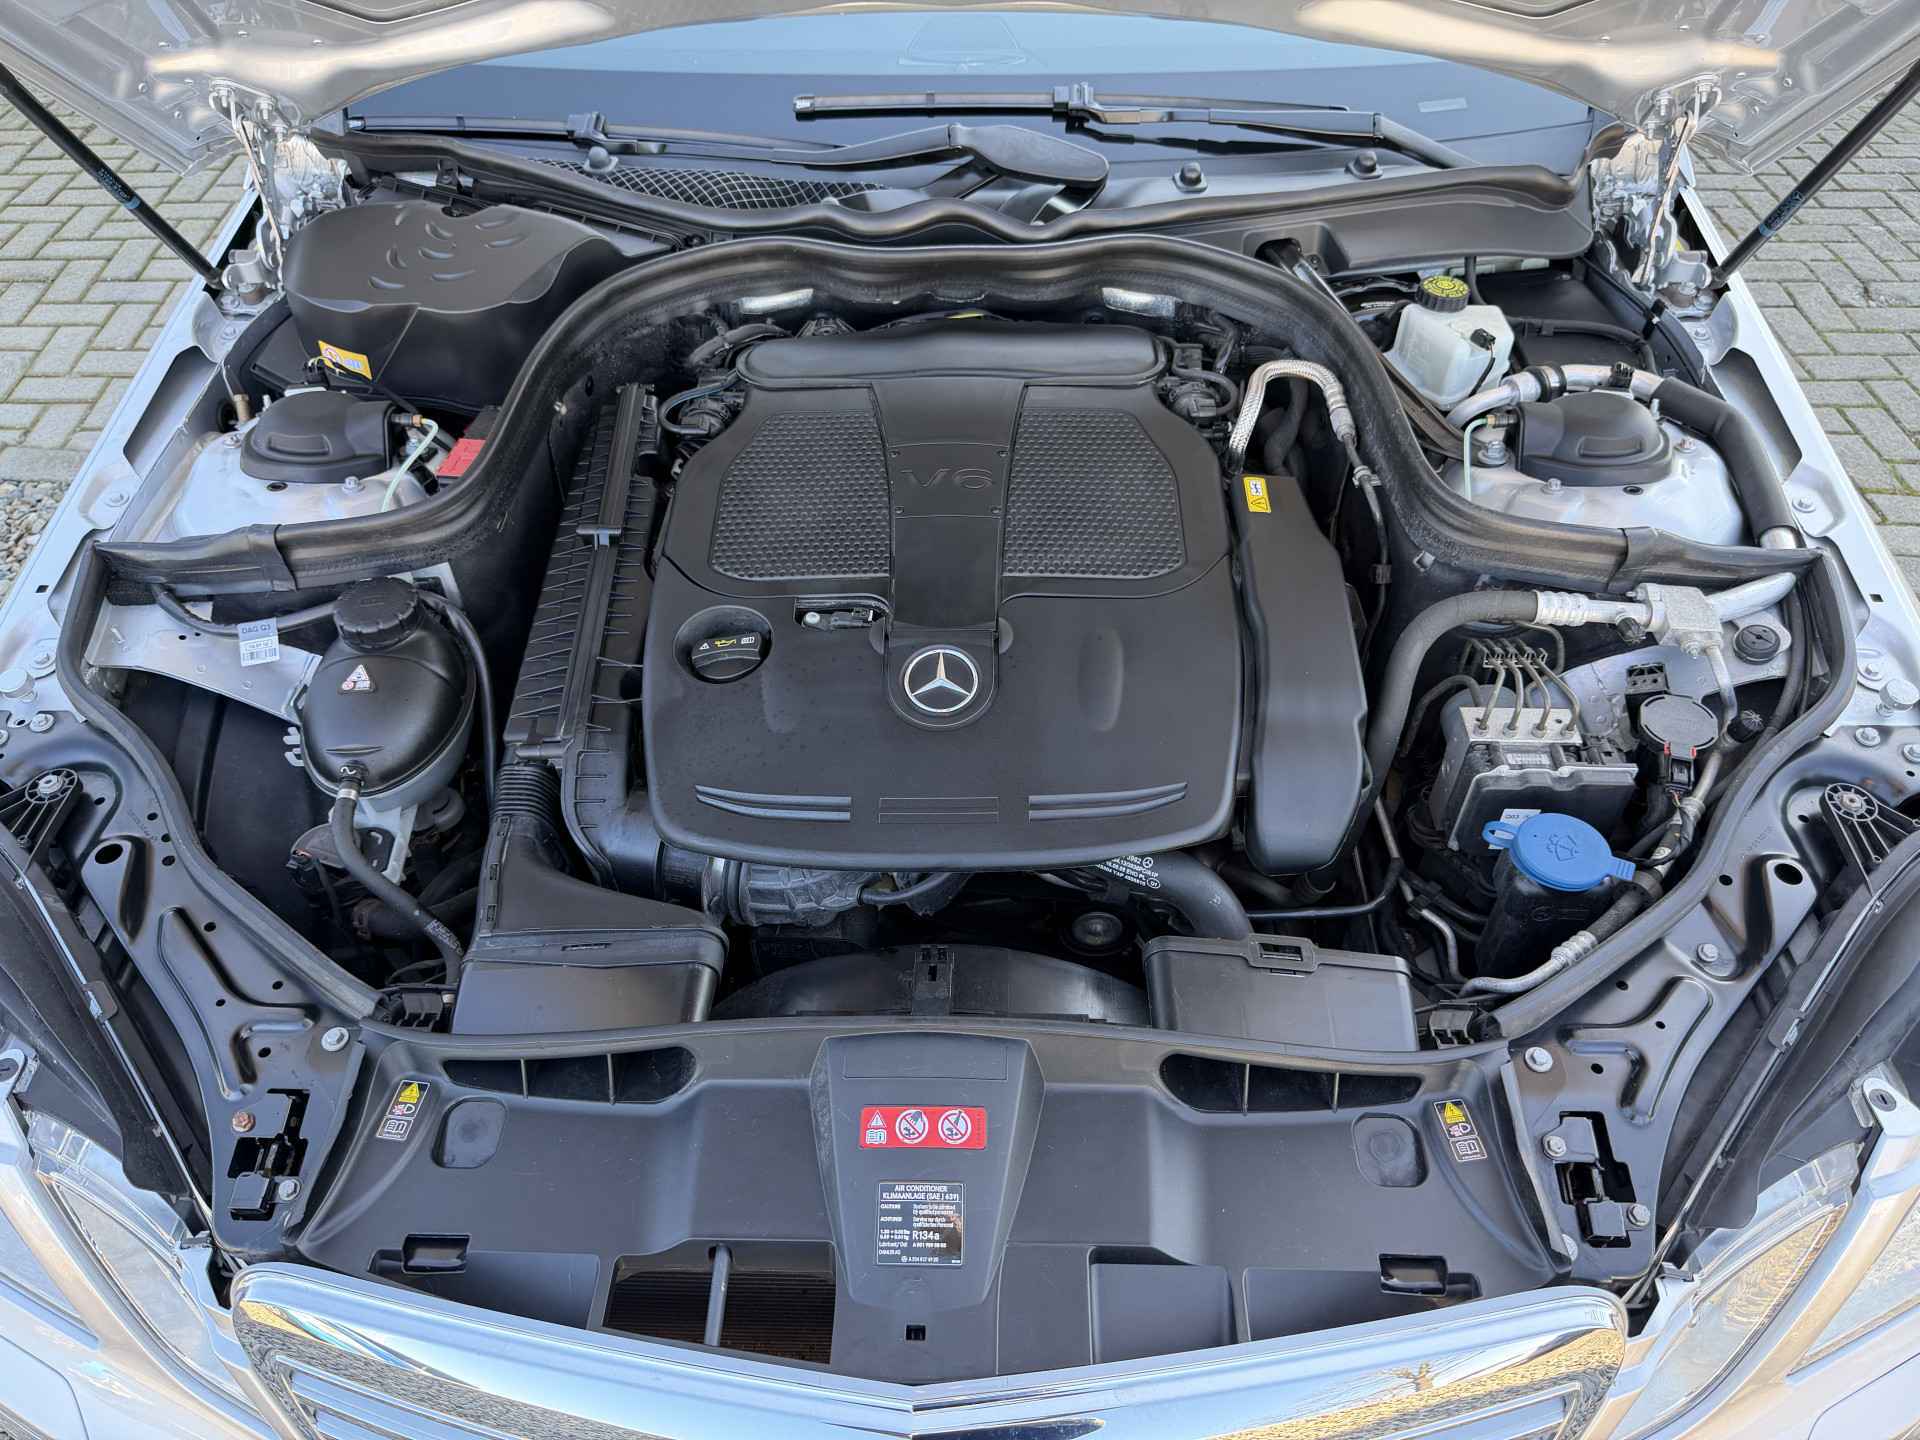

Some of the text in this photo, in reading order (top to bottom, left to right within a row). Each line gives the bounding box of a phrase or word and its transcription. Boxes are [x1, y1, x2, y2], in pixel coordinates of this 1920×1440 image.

[900, 466, 993, 490] V6
[894, 1184, 948, 1192] AIR CONDITIONER
[882, 1192, 926, 1200] KLIMAANLAGE
[912, 1230, 940, 1241] R134a
